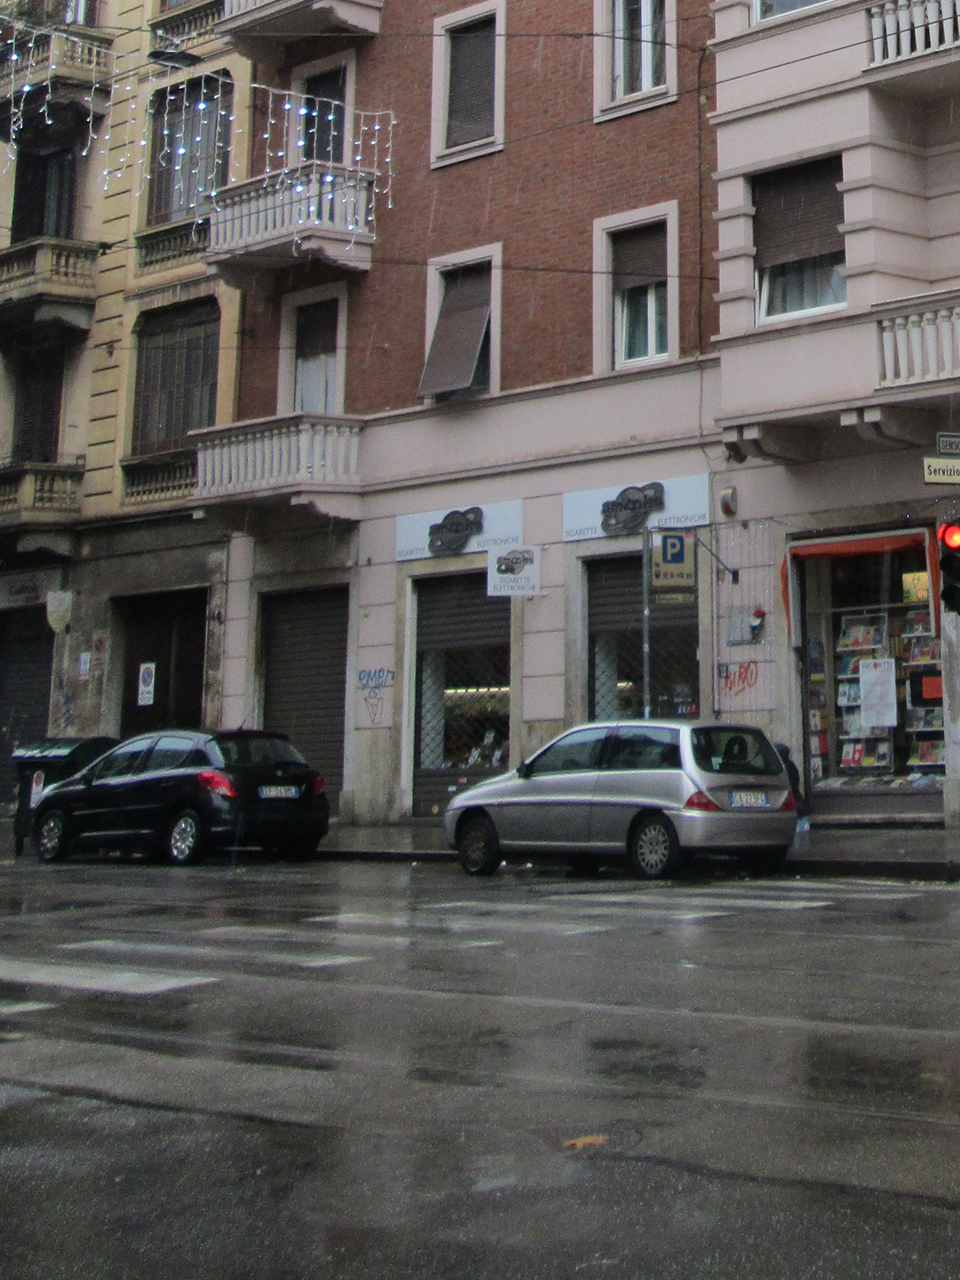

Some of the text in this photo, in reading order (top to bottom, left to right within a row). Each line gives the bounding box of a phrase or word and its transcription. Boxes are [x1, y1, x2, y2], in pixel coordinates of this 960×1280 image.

[941, 440, 960, 451] SENSO
[927, 464, 960, 476] Servizio
[657, 513, 707, 526] ELETTRONICHE
[667, 538, 680, 560] P
